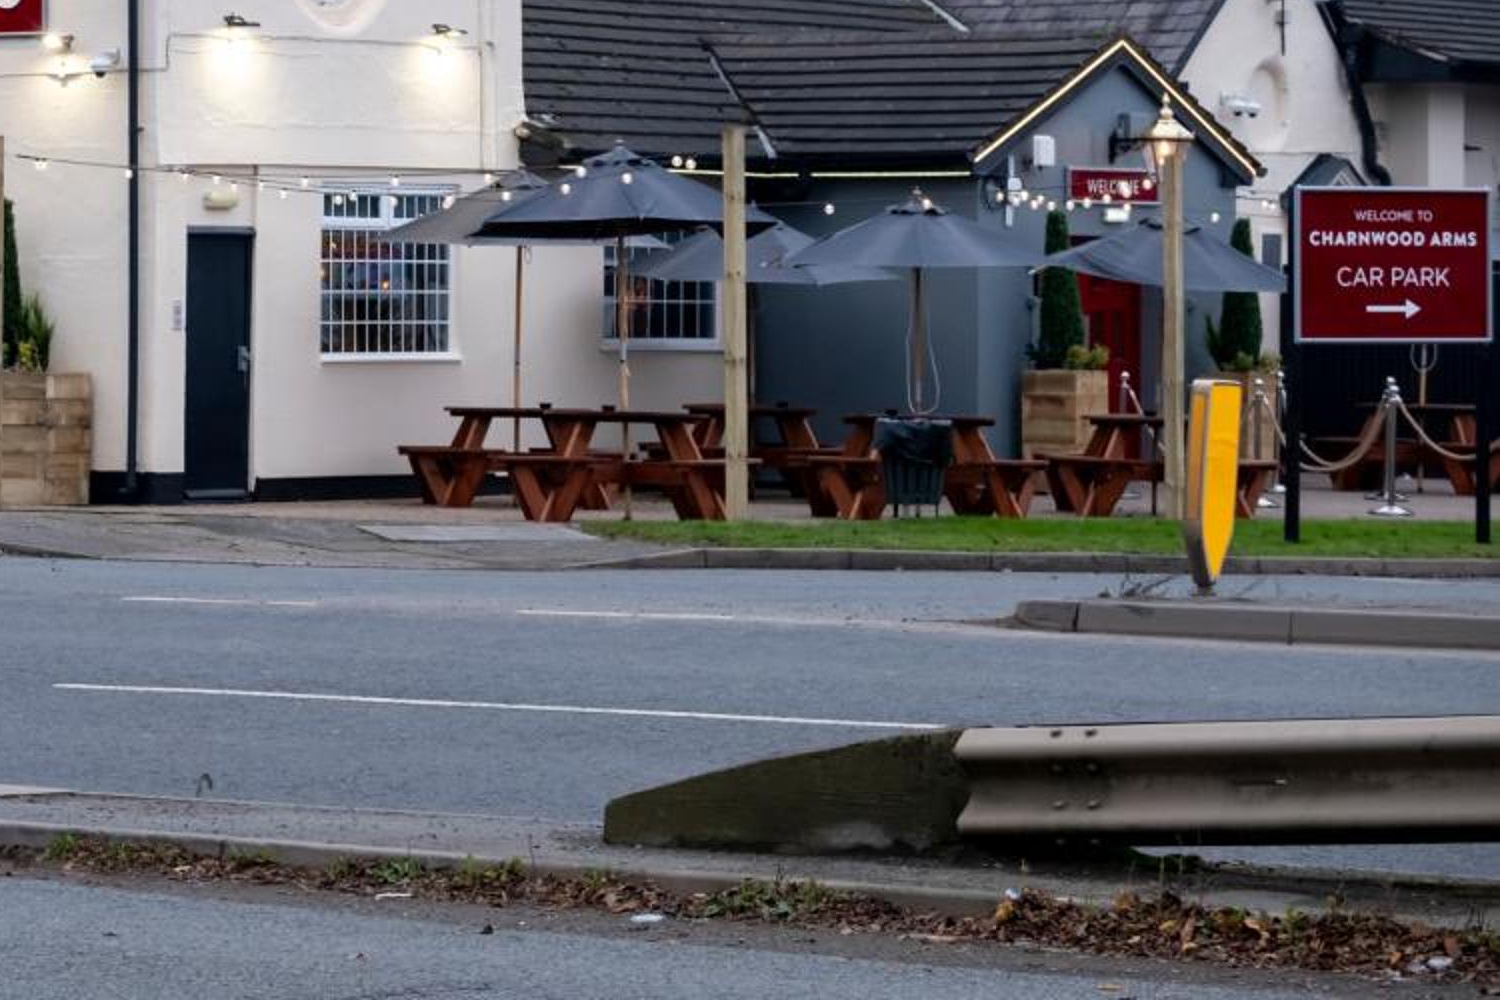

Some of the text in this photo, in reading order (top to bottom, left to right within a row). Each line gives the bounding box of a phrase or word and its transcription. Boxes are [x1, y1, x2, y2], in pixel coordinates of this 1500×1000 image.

[1354, 210, 1433, 222] WELCOME TO
[1309, 231, 1477, 246] CHARNWOOD ARMS
[1336, 267, 1450, 287] CAR PARK
